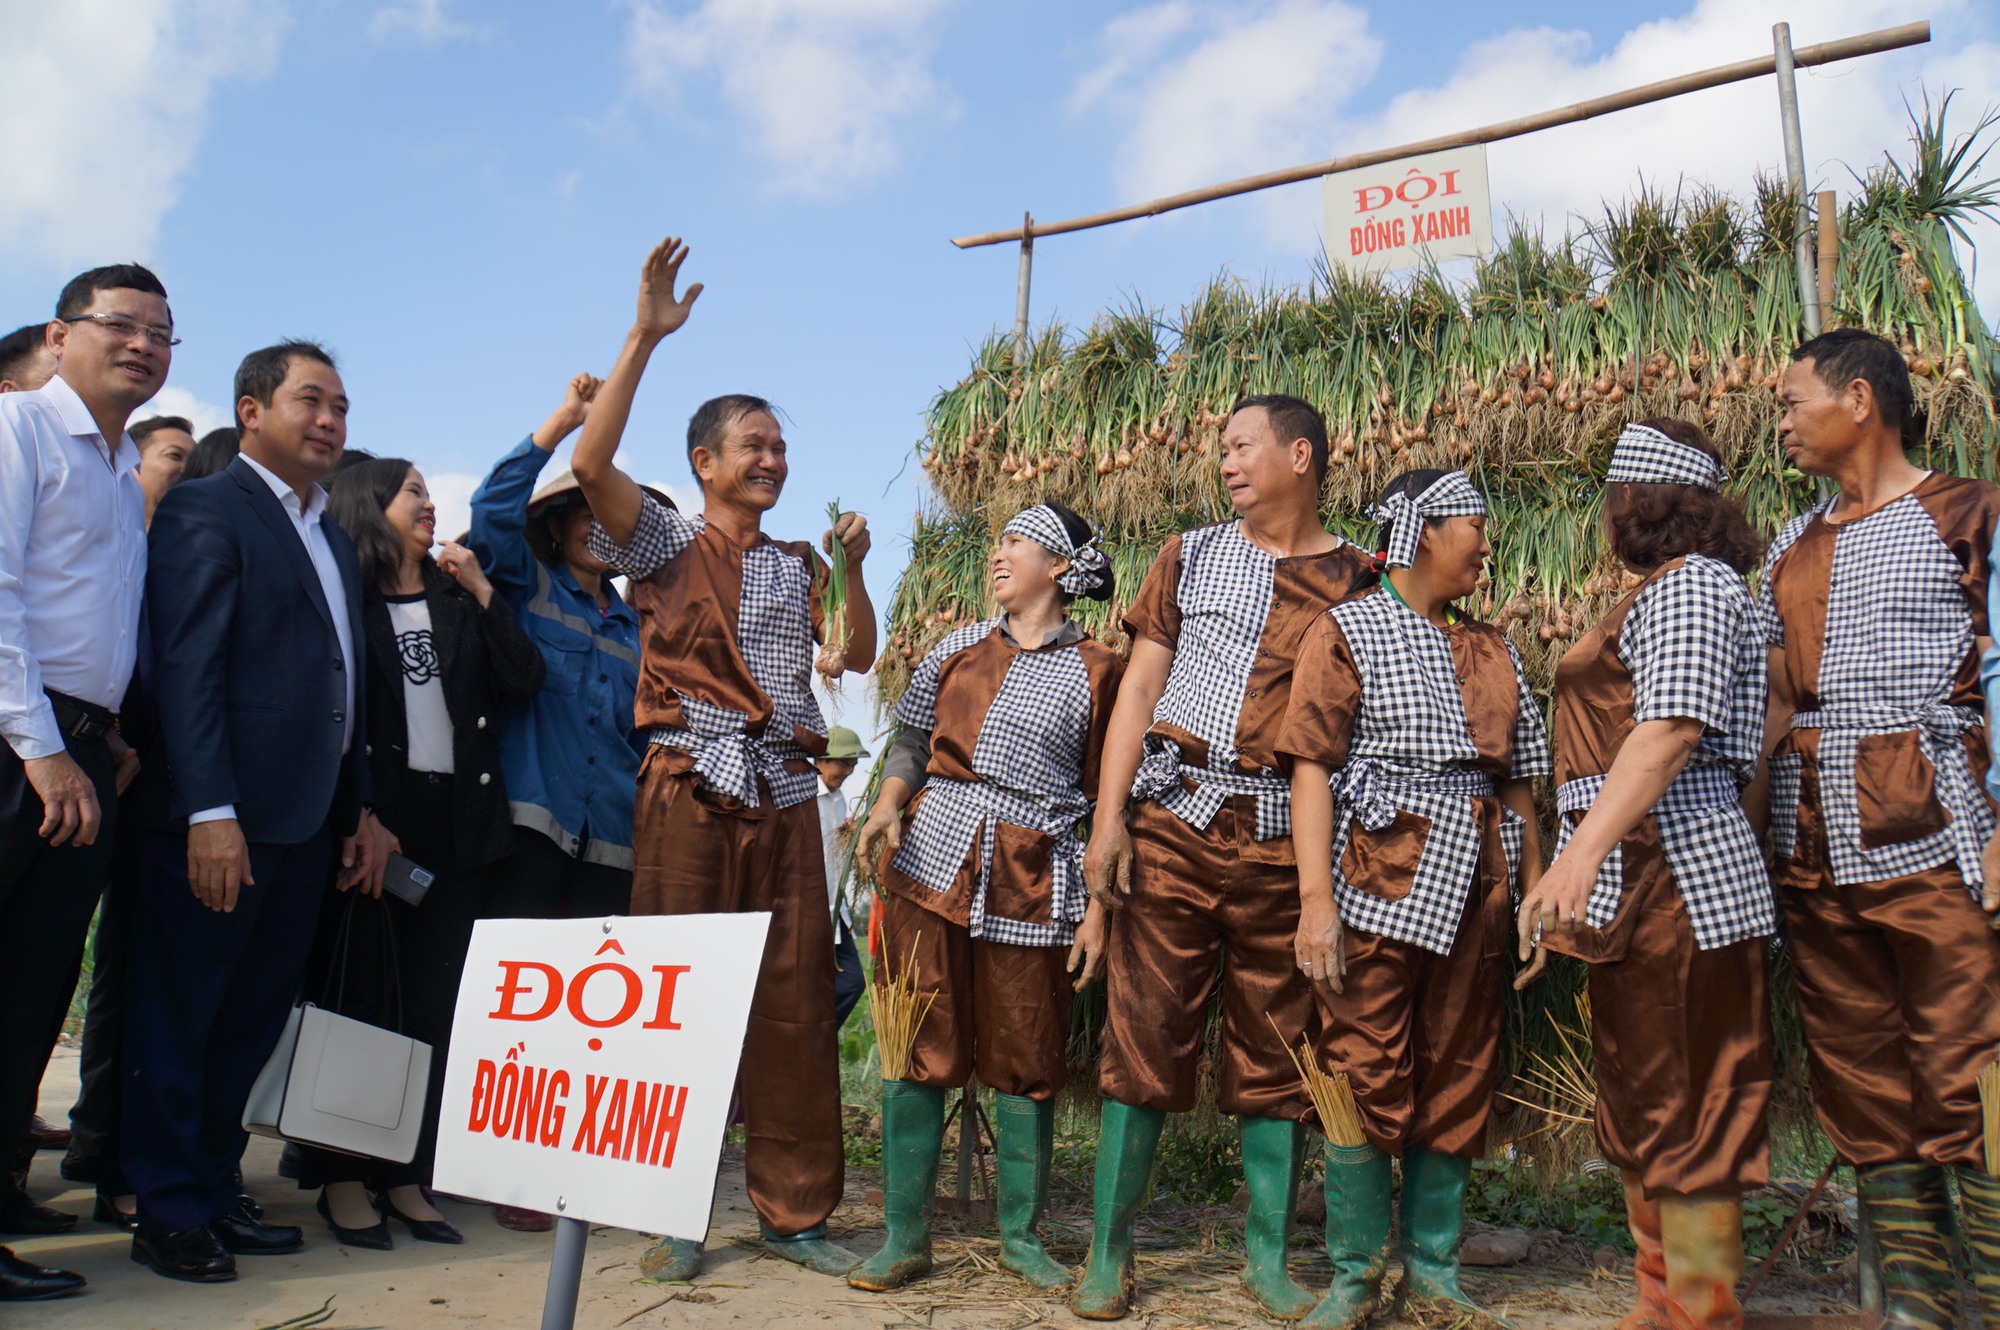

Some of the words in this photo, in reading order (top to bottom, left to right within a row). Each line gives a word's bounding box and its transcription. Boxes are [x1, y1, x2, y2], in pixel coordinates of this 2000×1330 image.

[1350, 216, 1406, 256] ĐỒNG
[1411, 206, 1471, 244] XANH
[1353, 168, 1461, 214] ĐỘI
[488, 939, 691, 1052] ĐỘI
[468, 1042, 570, 1149] ĐỒNG
[572, 1074, 689, 1169] XANH
